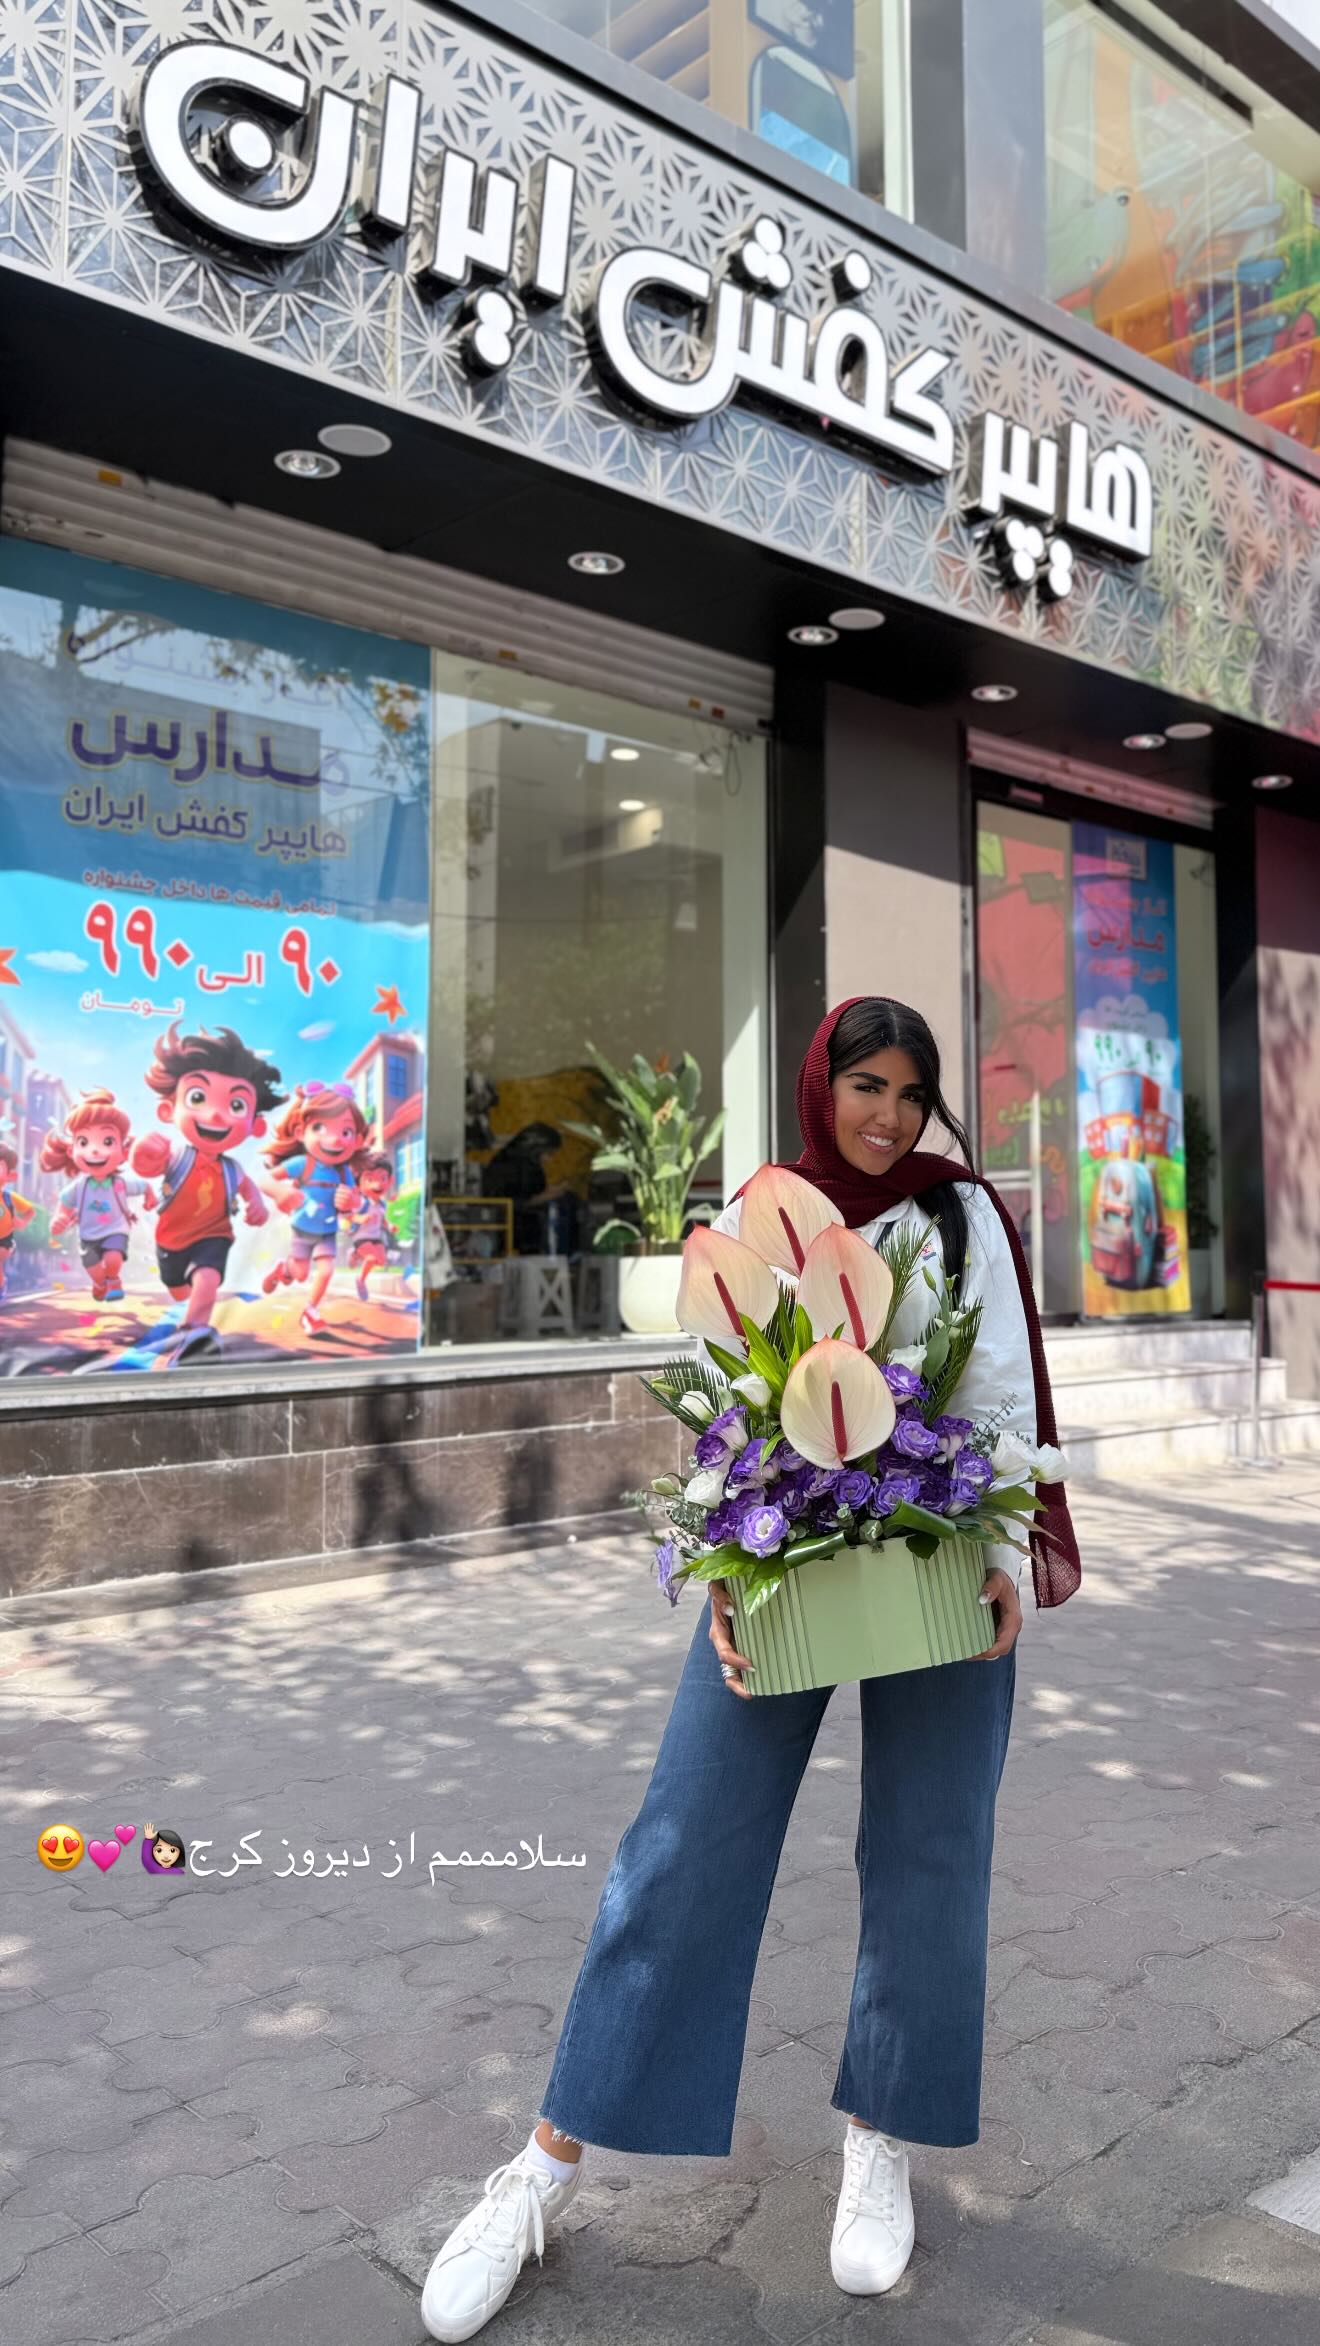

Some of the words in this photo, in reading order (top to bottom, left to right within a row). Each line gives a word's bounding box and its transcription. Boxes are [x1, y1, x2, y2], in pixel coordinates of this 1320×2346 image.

[139, 40, 577, 368] ایران
[595, 213, 954, 475] کفش
[981, 411, 1153, 598] هایپر
[71, 709, 350, 797] مدارس
[65, 786, 145, 830] ایران
[156, 798, 248, 839] کفش
[257, 822, 347, 861] هایپر
[83, 868, 156, 894] جشنواره
[162, 878, 206, 899] داخل
[210, 880, 229, 900] ها
[235, 888, 281, 910] قیمت
[86, 902, 191, 978] ۹۹۰
[198, 952, 264, 991] الی
[281, 928, 340, 994] ۹۰
[80, 991, 183, 1016] تومان
